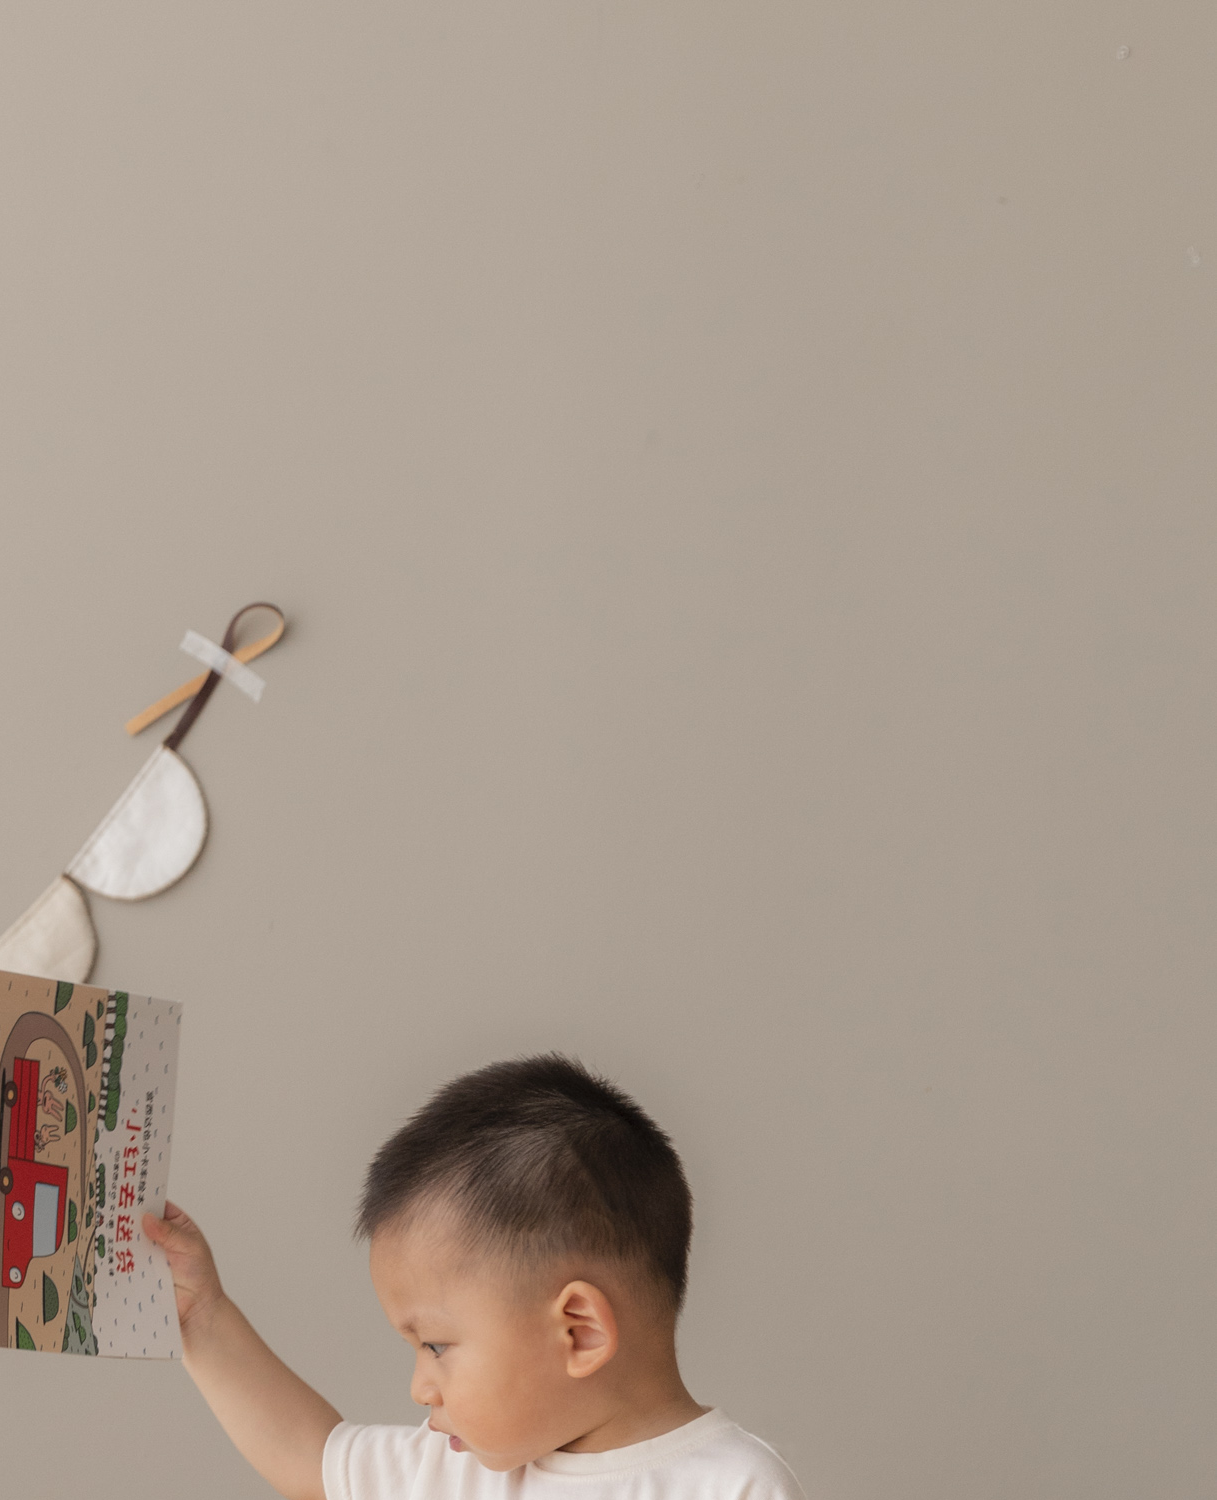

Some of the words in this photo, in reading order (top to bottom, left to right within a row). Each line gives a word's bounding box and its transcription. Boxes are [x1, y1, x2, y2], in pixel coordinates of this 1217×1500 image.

[115, 1108, 142, 1275] 小红去送货
